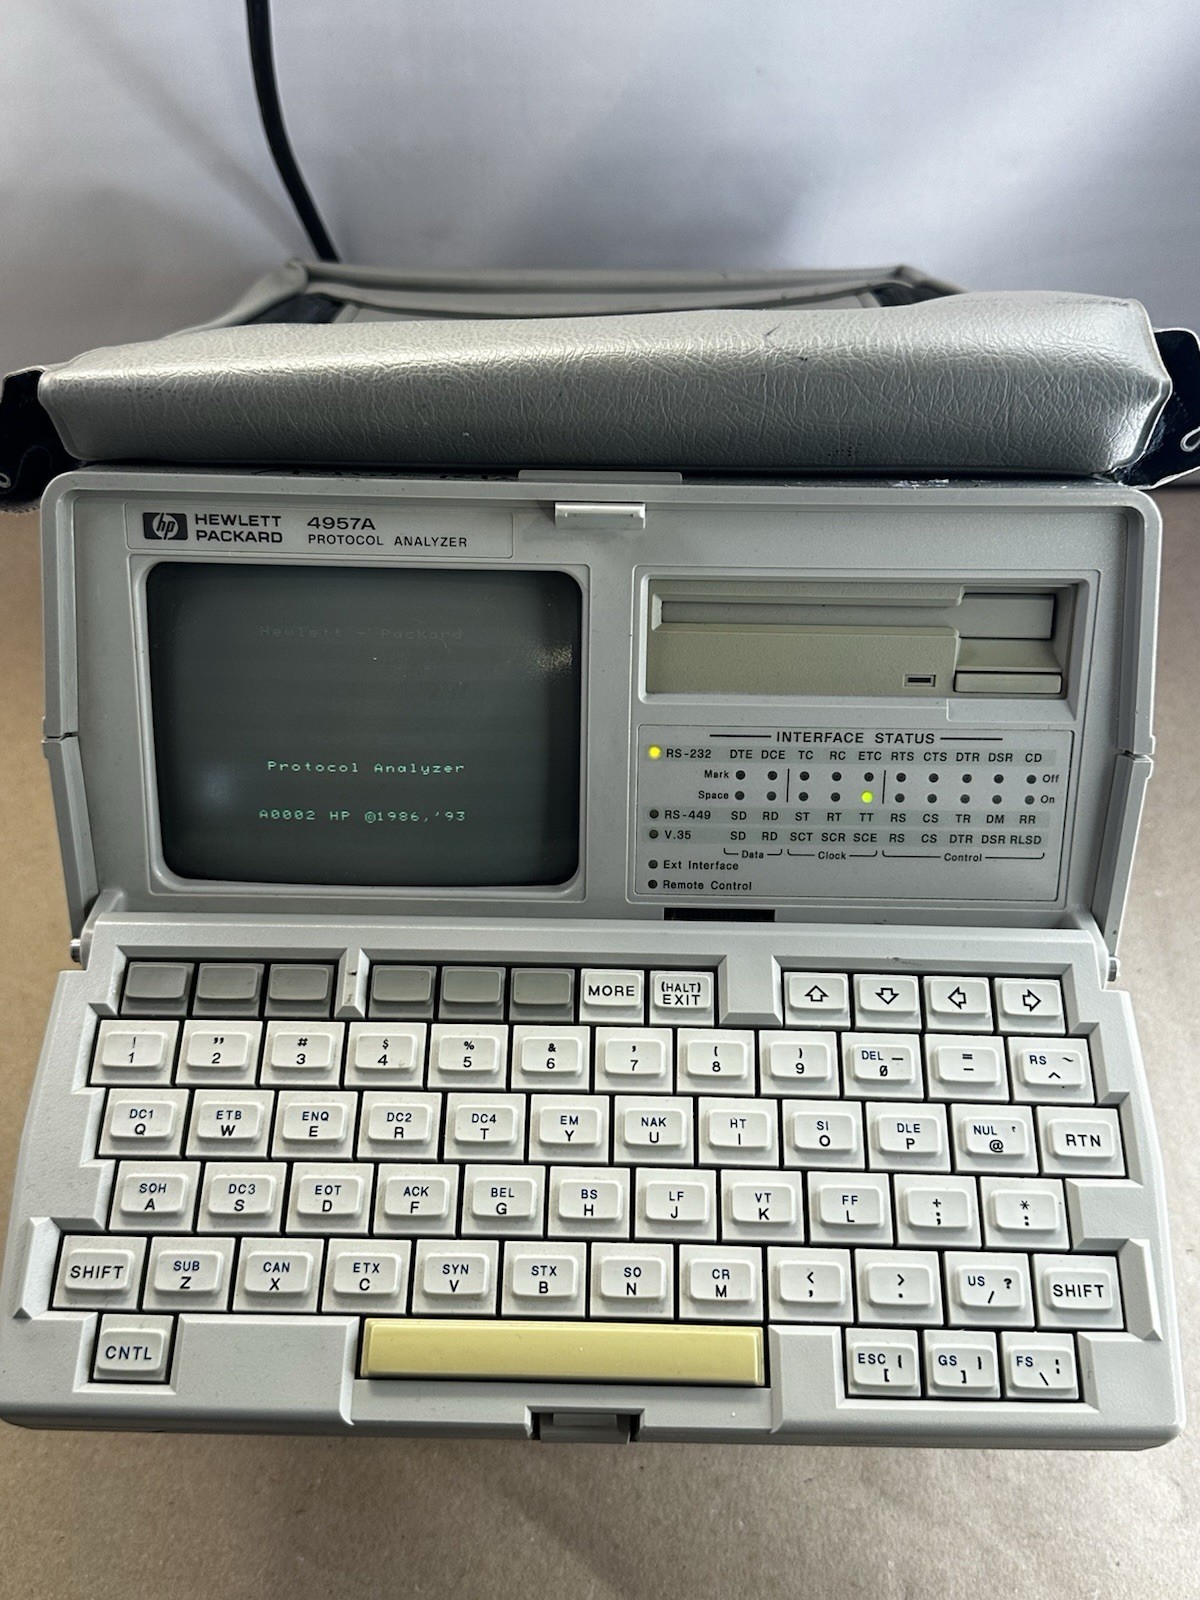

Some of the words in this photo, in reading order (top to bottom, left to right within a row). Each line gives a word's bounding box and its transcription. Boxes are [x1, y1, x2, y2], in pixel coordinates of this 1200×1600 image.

[195, 514, 281, 526] HEWLETT
[307, 517, 375, 530] 4957A
[153, 515, 175, 538] hp
[196, 530, 282, 543] PACKARD
[309, 534, 383, 545] PROTOCOL
[395, 536, 466, 547] ANALYZER
[260, 626, 341, 638] Hewlett
[380, 629, 463, 640] Packard
[777, 732, 863, 743] INTERFACE
[875, 733, 934, 744] STATUS
[667, 749, 711, 758] RS-232
[730, 750, 752, 759] DTE
[762, 750, 785, 759] DCE
[798, 750, 813, 759] TC
[830, 751, 845, 760] RC
[859, 751, 881, 760] ETC
[891, 752, 914, 761] RTS
[924, 752, 947, 761] CTS
[956, 752, 979, 761] DTR
[989, 753, 1012, 762] DSR
[1025, 753, 1041, 762] CD
[268, 761, 357, 772] Protocol
[375, 764, 464, 775] Analyzer
[705, 770, 729, 778] Mark
[1043, 774, 1059, 783] Off
[699, 790, 728, 800] Space
[1040, 795, 1055, 803] On
[330, 811, 349, 820] HP
[665, 810, 710, 819] RS-449
[731, 811, 746, 820] SD
[763, 812, 778, 820] RD
[795, 812, 810, 821] ST
[827, 813, 842, 821] RT
[859, 813, 874, 821] TT
[891, 813, 906, 822] RS
[923, 814, 938, 823] CS
[955, 814, 971, 823] TR
[987, 815, 1004, 823] DM
[1020, 815, 1035, 823] RR
[665, 830, 691, 839] V.35
[731, 831, 746, 840] SD
[762, 832, 777, 840] RD
[790, 832, 813, 841] SCT
[822, 833, 845, 842] SCR
[853, 833, 877, 842] SCE
[889, 834, 905, 842] RS
[922, 834, 937, 843] CS
[950, 835, 972, 843] DTR
[982, 835, 1005, 844] DSR
[1010, 835, 1041, 844] RLSD
[742, 850, 763, 858] Data
[818, 851, 846, 859] Clock
[944, 853, 982, 861] Control
[664, 860, 681, 869] Ext
[689, 861, 738, 870] Interface
[663, 880, 704, 889] Remote
[711, 881, 751, 890] Control
[589, 985, 634, 996] MORE
[661, 982, 701, 993] (HALT)
[663, 994, 700, 1005] EXIT
[297, 1038, 308, 1046] #
[463, 1041, 475, 1050] %
[547, 1043, 557, 1052] &
[211, 1053, 221, 1063] 2
[296, 1054, 306, 1064] 3
[377, 1054, 388, 1065] 4
[862, 1051, 883, 1060] DEL
[1030, 1055, 1046, 1065] RS
[463, 1057, 473, 1067] 5
[546, 1058, 556, 1069] 6
[630, 1060, 639, 1071] 7
[711, 1061, 721, 1072] 8
[795, 1063, 805, 1074] 9
[130, 1109, 153, 1119] DC1
[216, 1110, 241, 1120] ETB
[302, 1112, 329, 1121] ENQ
[387, 1112, 411, 1122] DC2
[472, 1114, 496, 1123] DC4
[561, 1116, 578, 1125] EM
[642, 1117, 666, 1127] NAK
[731, 1119, 746, 1128] HT
[816, 1121, 829, 1130] SI
[134, 1124, 147, 1135] Q
[220, 1125, 236, 1136] W
[308, 1126, 319, 1137] E
[393, 1127, 404, 1138] R
[479, 1128, 490, 1139] T
[897, 1123, 920, 1133] DLE
[974, 1125, 997, 1135] NUL
[564, 1130, 575, 1141] Y
[649, 1132, 660, 1143] U
[818, 1135, 831, 1147] O
[1066, 1134, 1100, 1146] RTN
[905, 1138, 916, 1149] P
[988, 1140, 1004, 1153] @
[139, 1183, 166, 1193] SOH
[229, 1184, 255, 1194] DC3
[315, 1185, 341, 1195] EOT
[404, 1187, 429, 1196] ACK
[491, 1188, 514, 1197] BEL
[582, 1189, 597, 1199] BS
[669, 1192, 684, 1201] LF
[755, 1193, 771, 1202] VT
[144, 1198, 156, 1210] A
[233, 1199, 245, 1211] S
[842, 1195, 857, 1205] FF
[321, 1200, 333, 1212] D
[410, 1201, 420, 1213] F
[495, 1203, 508, 1215] G
[583, 1204, 594, 1216] H
[670, 1206, 679, 1218] J
[758, 1208, 770, 1220] K
[846, 1210, 855, 1222] L
[174, 1261, 199, 1271] SUB
[263, 1262, 290, 1272] CAN
[353, 1263, 379, 1273] ETX
[443, 1264, 468, 1274] SYN
[532, 1266, 556, 1276] STX
[71, 1266, 123, 1278] SHIFT
[624, 1267, 641, 1277] SO
[712, 1269, 729, 1279] CR
[179, 1277, 192, 1289] Z
[269, 1278, 281, 1290] X
[358, 1278, 371, 1291] C
[449, 1280, 460, 1292] V
[968, 1276, 985, 1286] US
[1003, 1278, 1013, 1289] ?
[538, 1281, 549, 1293] B
[626, 1283, 637, 1295] N
[715, 1285, 727, 1297] M
[1053, 1284, 1103, 1297] SHIFT
[987, 1291, 995, 1303] /
[106, 1346, 151, 1360] CNTL
[858, 1353, 885, 1364] ESC
[938, 1355, 957, 1366] GS
[1017, 1356, 1033, 1367] FS
